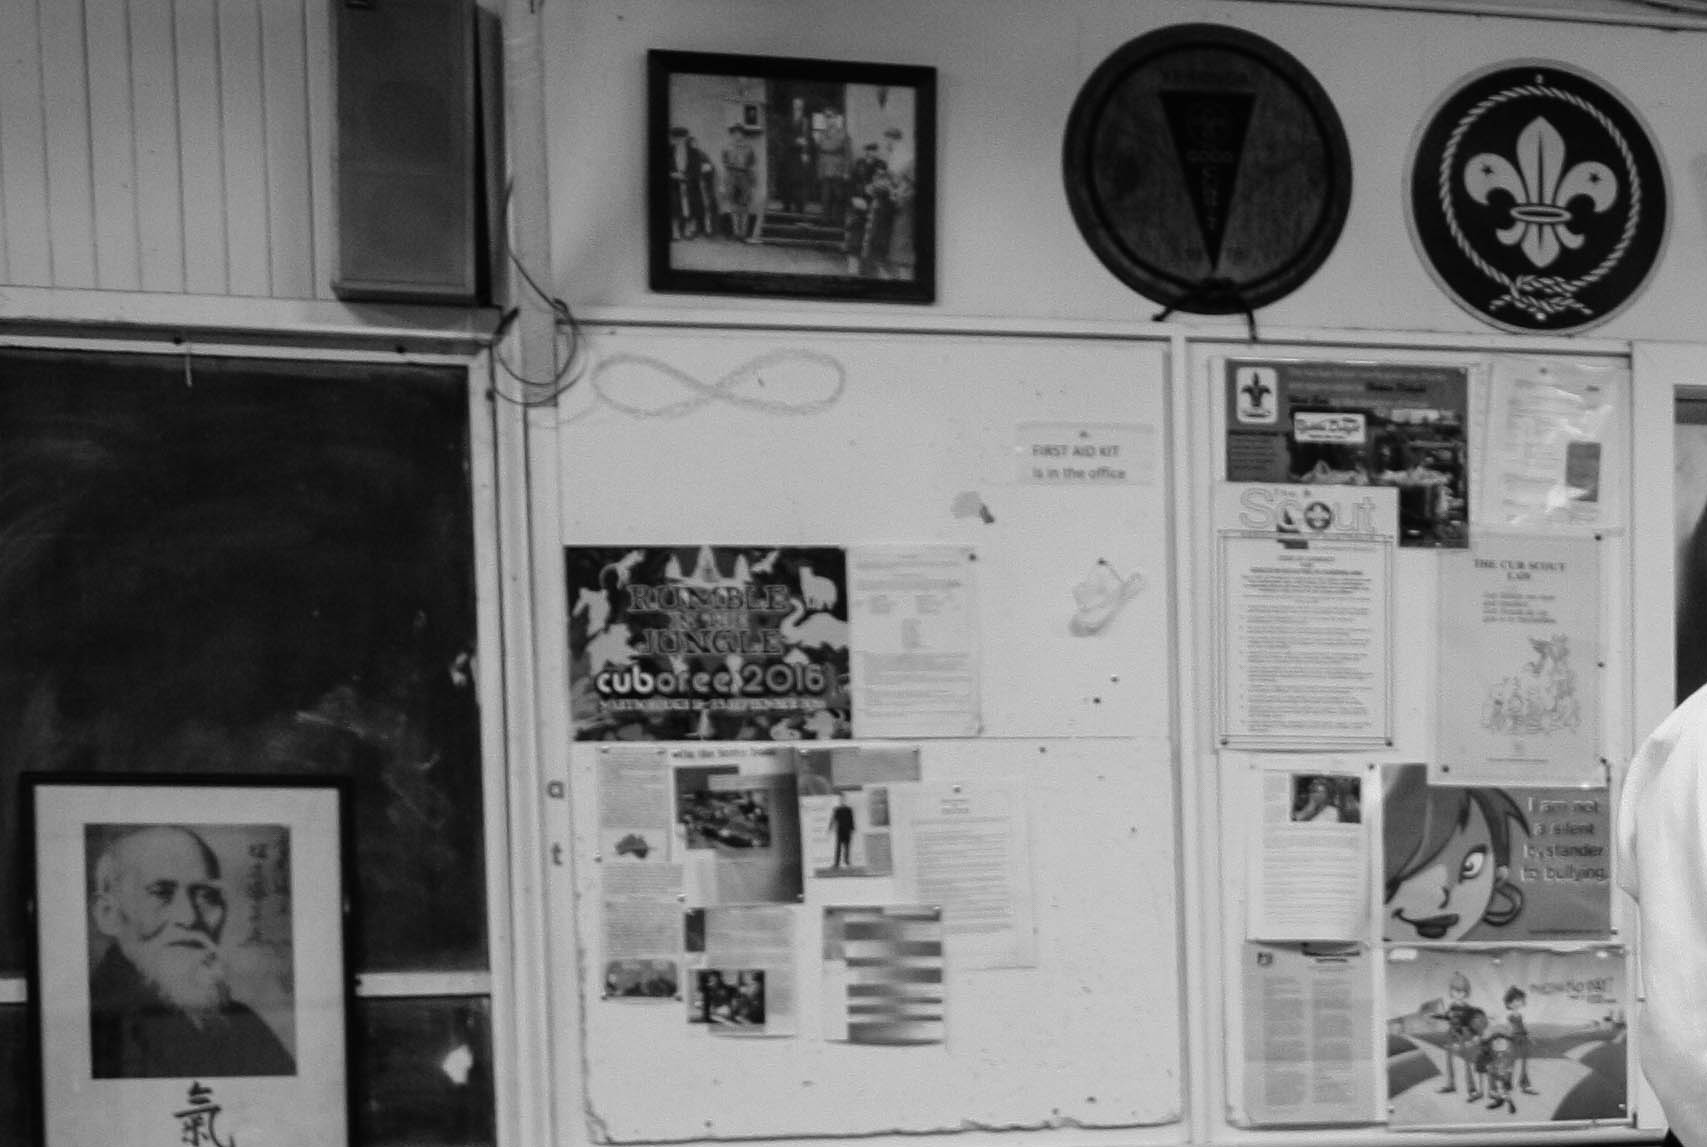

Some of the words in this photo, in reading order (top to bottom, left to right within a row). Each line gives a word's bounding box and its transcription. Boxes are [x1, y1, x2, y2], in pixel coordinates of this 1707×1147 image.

[1032, 444, 1067, 457] FIRST
[1071, 444, 1096, 457] AID
[1099, 444, 1120, 457] KIT
[1062, 467, 1085, 479] the
[1088, 466, 1126, 480] office
[626, 584, 792, 612] RUMBLE
[637, 628, 785, 656] JUNGLE
[596, 664, 732, 695] cuboree
[742, 664, 825, 693] 2016
[1551, 821, 1595, 836] silent
[1523, 843, 1605, 861] bystander
[1520, 865, 1539, 881] to
